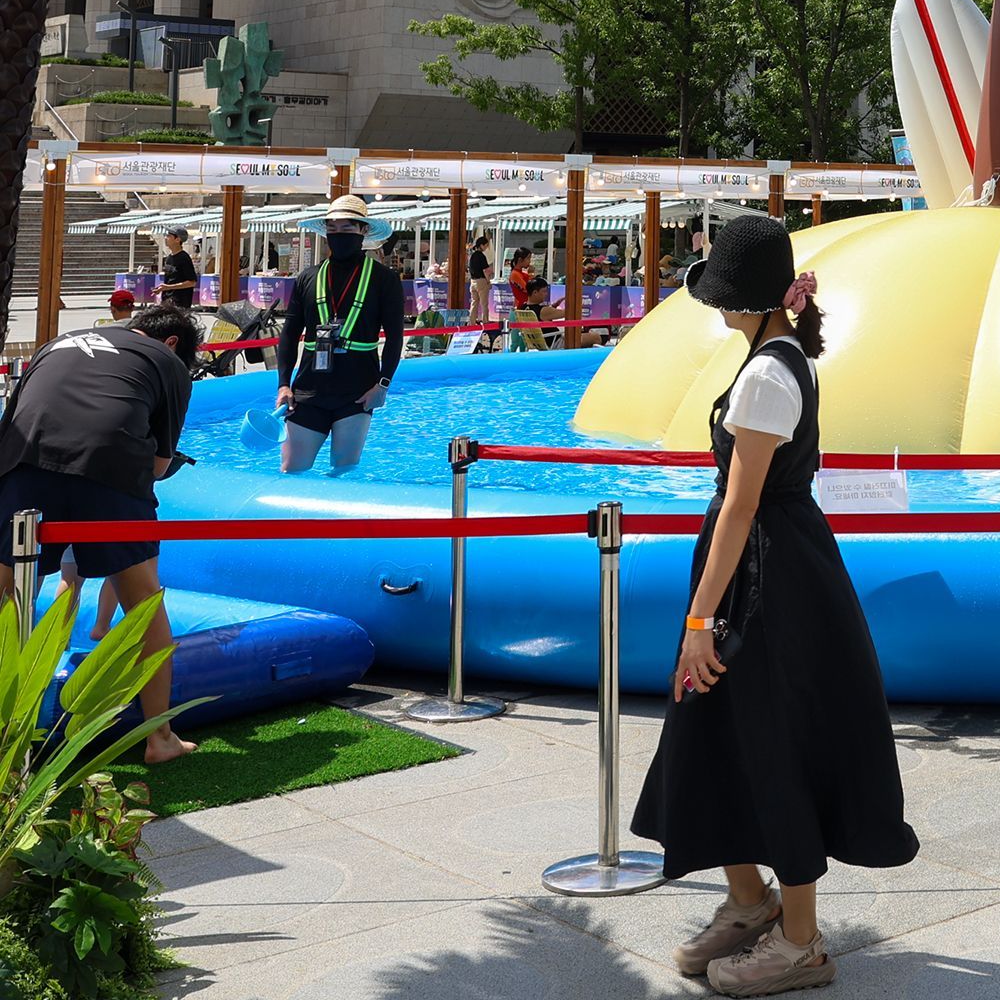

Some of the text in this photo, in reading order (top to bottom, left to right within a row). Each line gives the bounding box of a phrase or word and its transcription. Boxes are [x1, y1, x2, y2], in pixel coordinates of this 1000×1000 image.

[123, 161, 176, 173] 서울관광재단
[278, 165, 300, 176] SOUL
[397, 167, 440, 178] 서울관광재단
[525, 170, 544, 181] SOUL
[732, 175, 749, 185] SOUL
